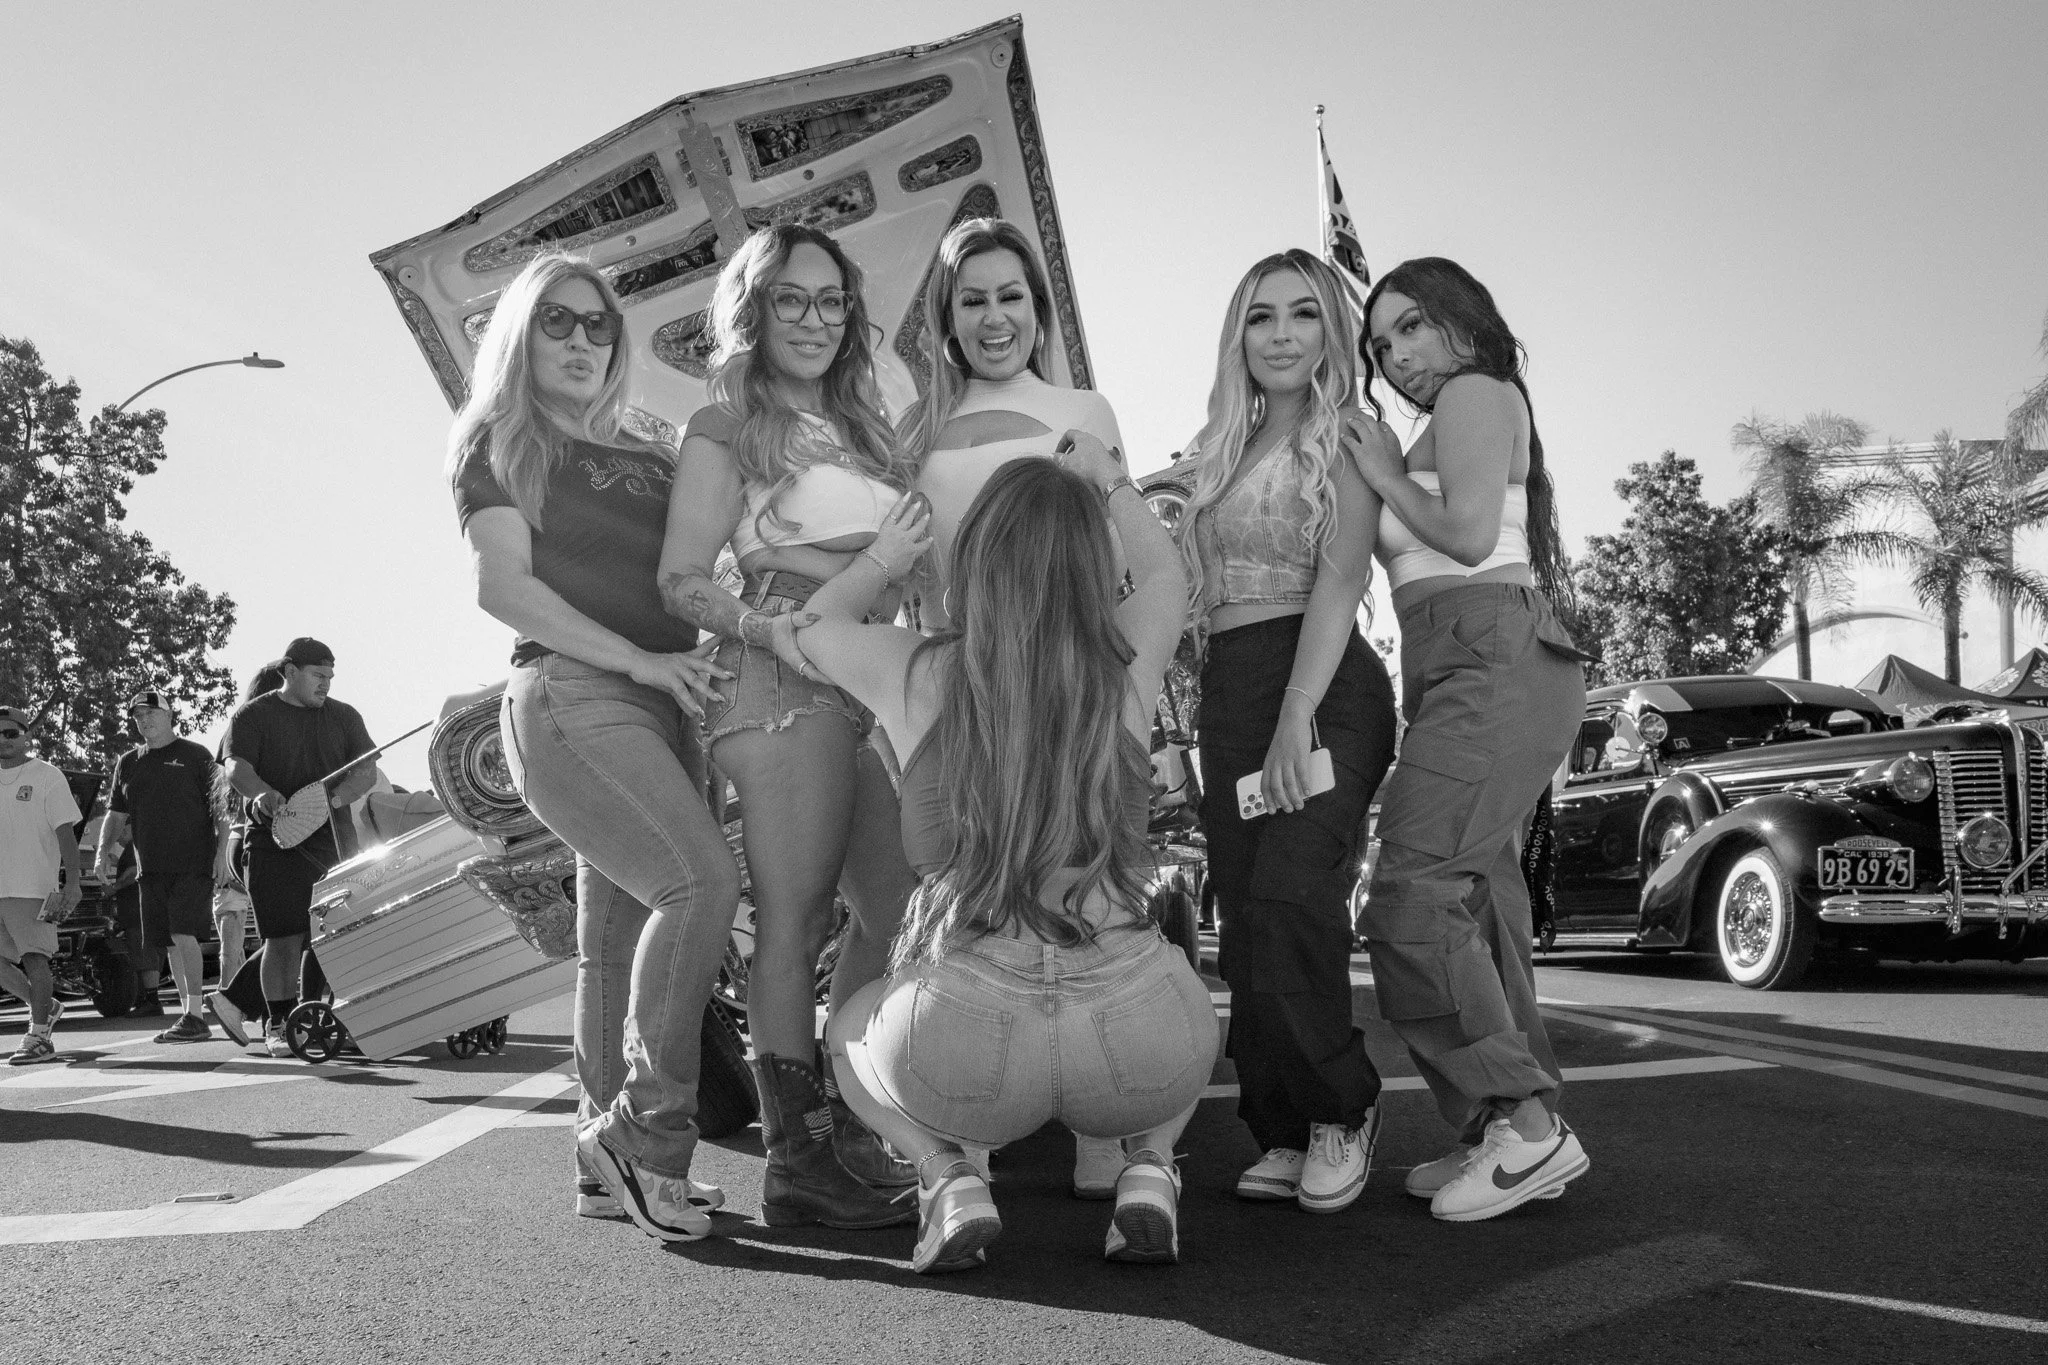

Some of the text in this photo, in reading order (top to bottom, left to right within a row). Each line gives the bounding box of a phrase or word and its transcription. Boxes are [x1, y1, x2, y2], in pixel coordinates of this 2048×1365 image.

[1824, 858, 1909, 884] 9B 69 25
